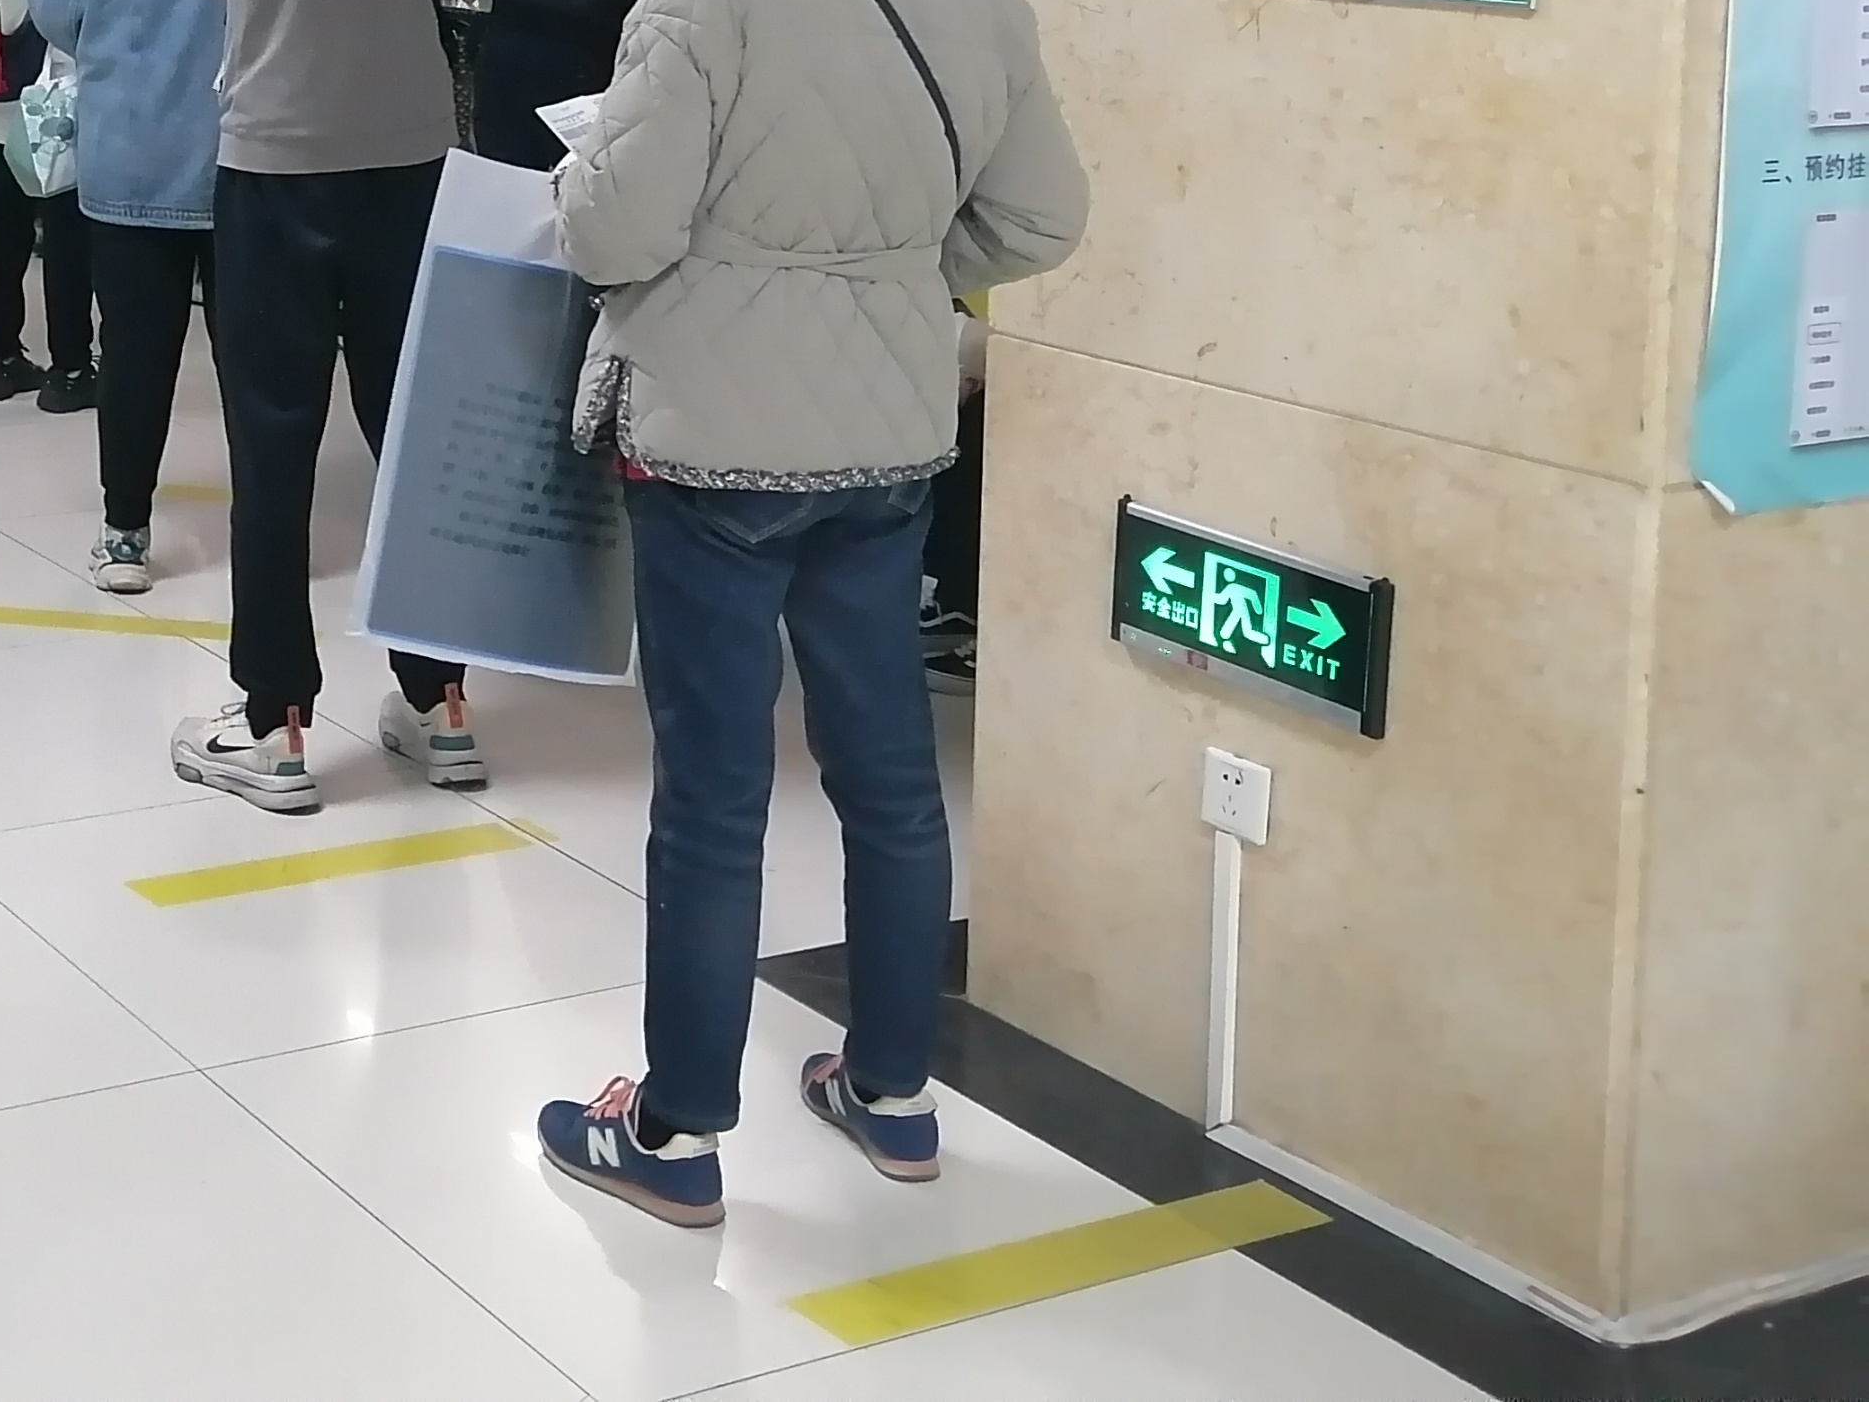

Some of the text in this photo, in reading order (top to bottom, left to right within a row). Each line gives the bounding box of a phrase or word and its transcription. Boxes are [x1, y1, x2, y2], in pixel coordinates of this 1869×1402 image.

[1762, 153, 1867, 183] 三、预约挂
[1141, 591, 1199, 630] 安全出口
[1283, 643, 1341, 681] EXIT
[587, 1126, 621, 1168] N
